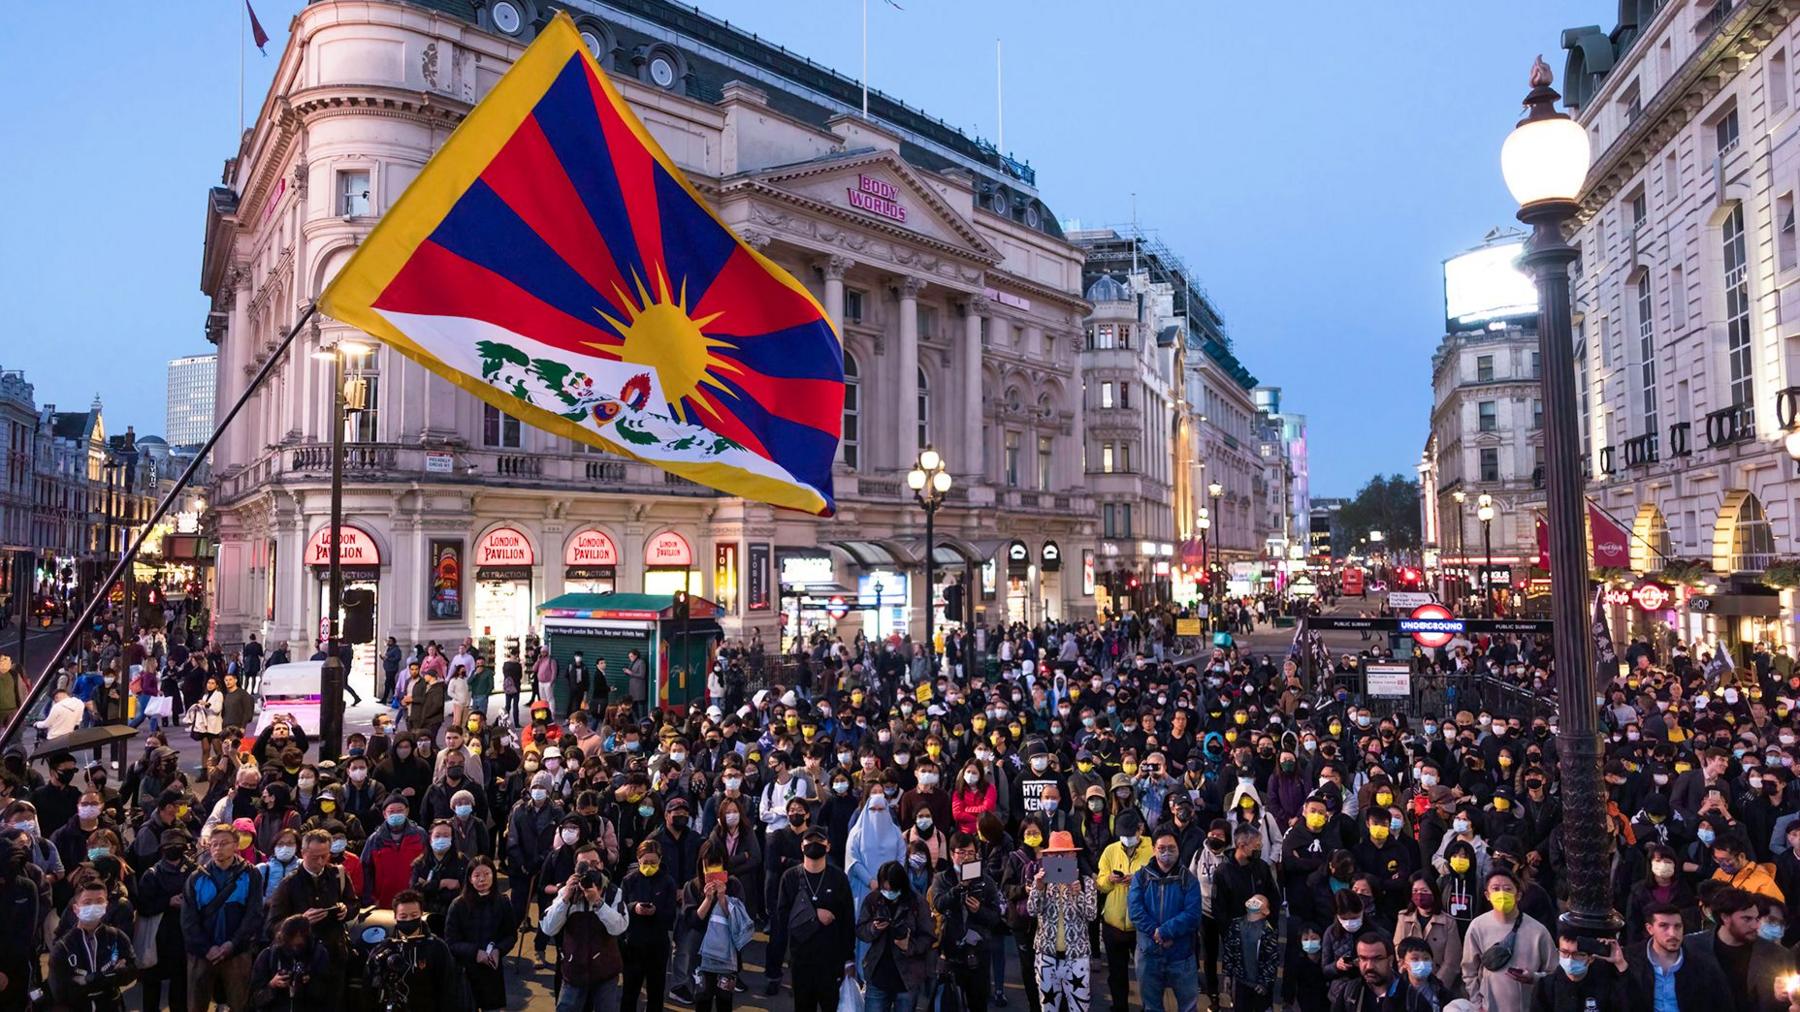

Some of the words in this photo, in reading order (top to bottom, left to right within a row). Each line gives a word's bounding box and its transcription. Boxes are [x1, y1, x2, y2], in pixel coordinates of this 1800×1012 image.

[860, 175, 899, 201] BODY
[849, 189, 907, 222] WORLDS
[321, 533, 356, 545] LODON
[489, 535, 519, 547] LONDON
[578, 537, 605, 548] LONDON
[485, 546, 525, 561] PAVILION
[573, 547, 610, 561] PAVILION
[656, 548, 681, 558] PAVILION
[481, 571, 528, 579] ATTRACTION
[570, 569, 611, 578] ATTRACTION
[1690, 599, 1709, 610] SHOP
[1401, 621, 1463, 631] UNDERGROUND
[1024, 798, 1045, 811] KEN
